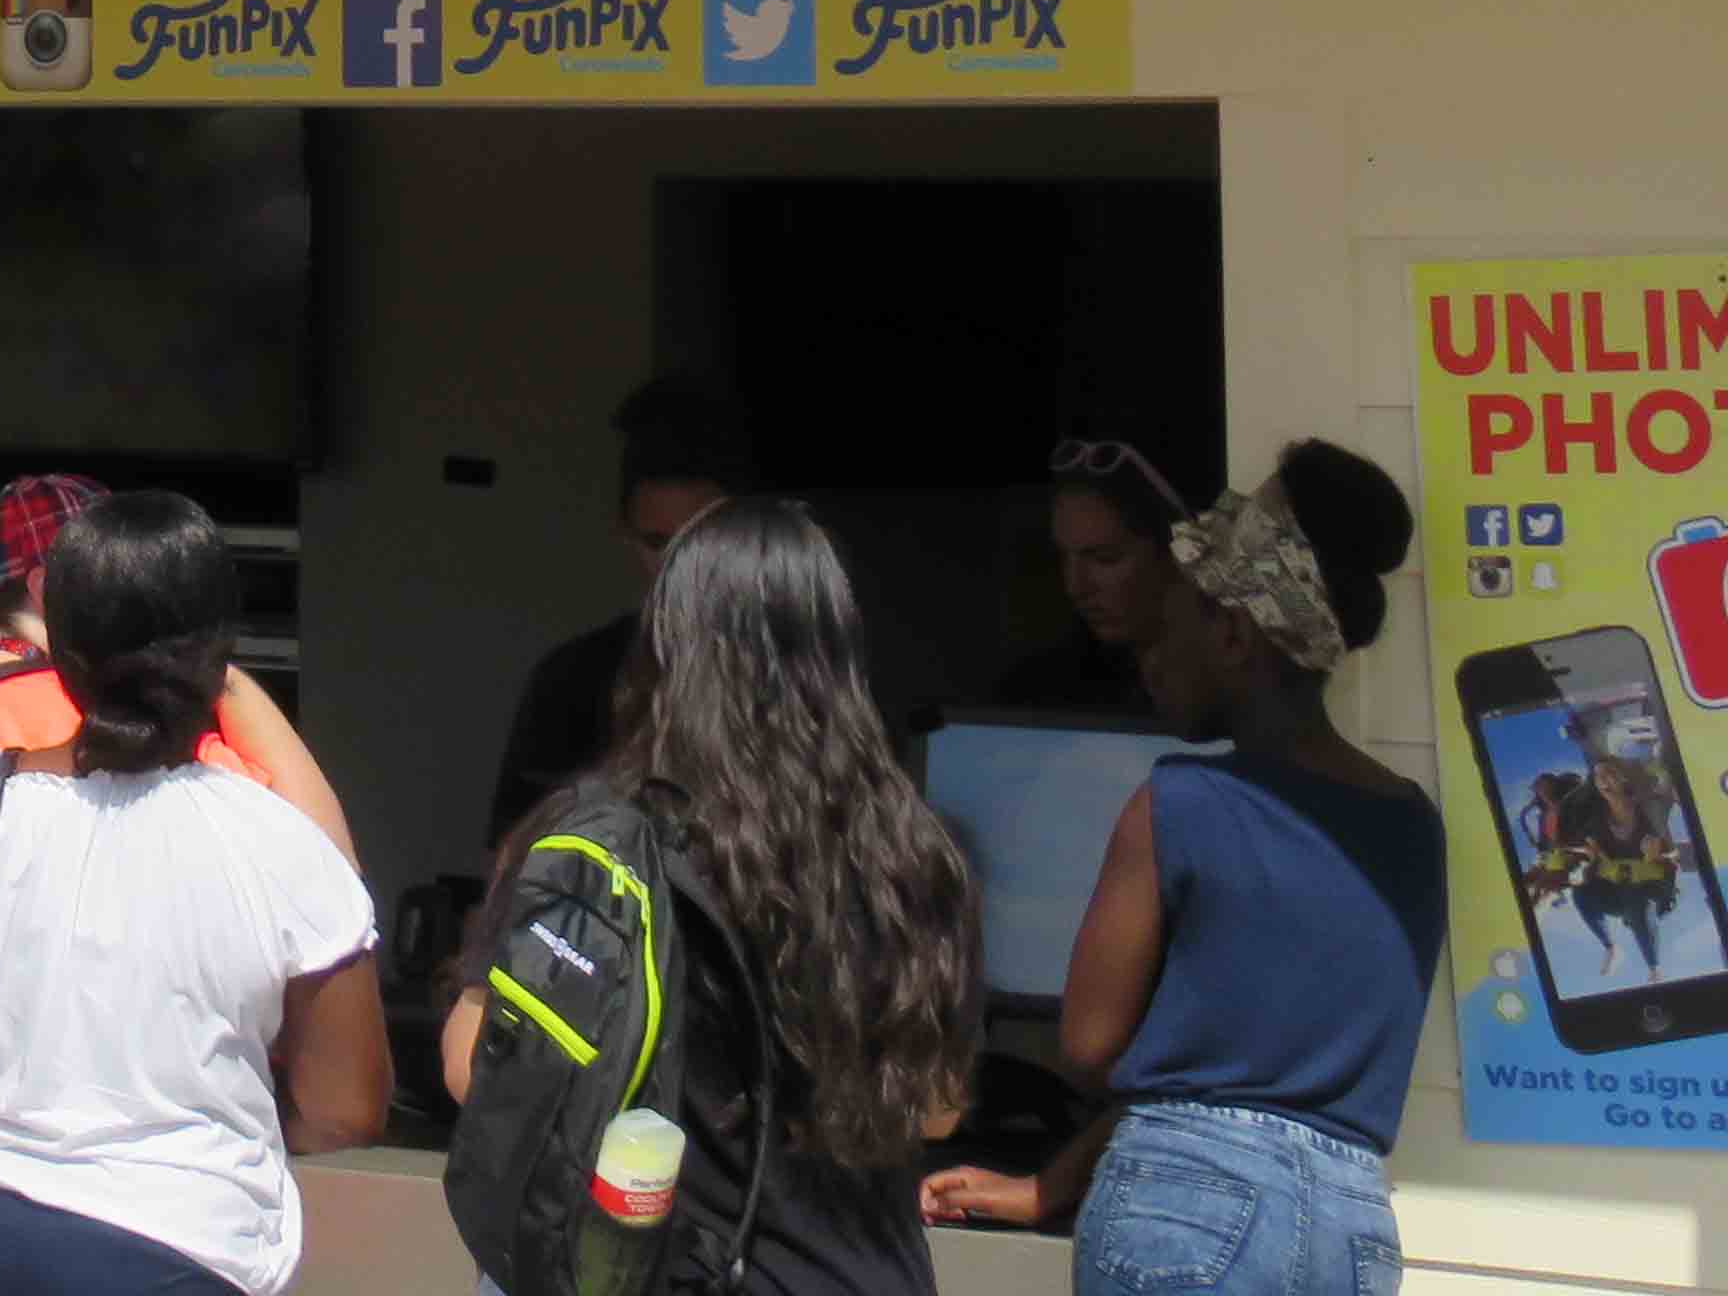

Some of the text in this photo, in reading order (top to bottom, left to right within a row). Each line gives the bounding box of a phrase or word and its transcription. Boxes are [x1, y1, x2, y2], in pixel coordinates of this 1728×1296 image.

[1430, 289, 1728, 376] UNLIM
[1467, 389, 1728, 476] PHO
[1482, 1063, 1575, 1092] Want
[1584, 1067, 1620, 1094] to
[1629, 1069, 1702, 1101] sign
[1603, 1103, 1652, 1129] Go
[1661, 1105, 1698, 1131] to
